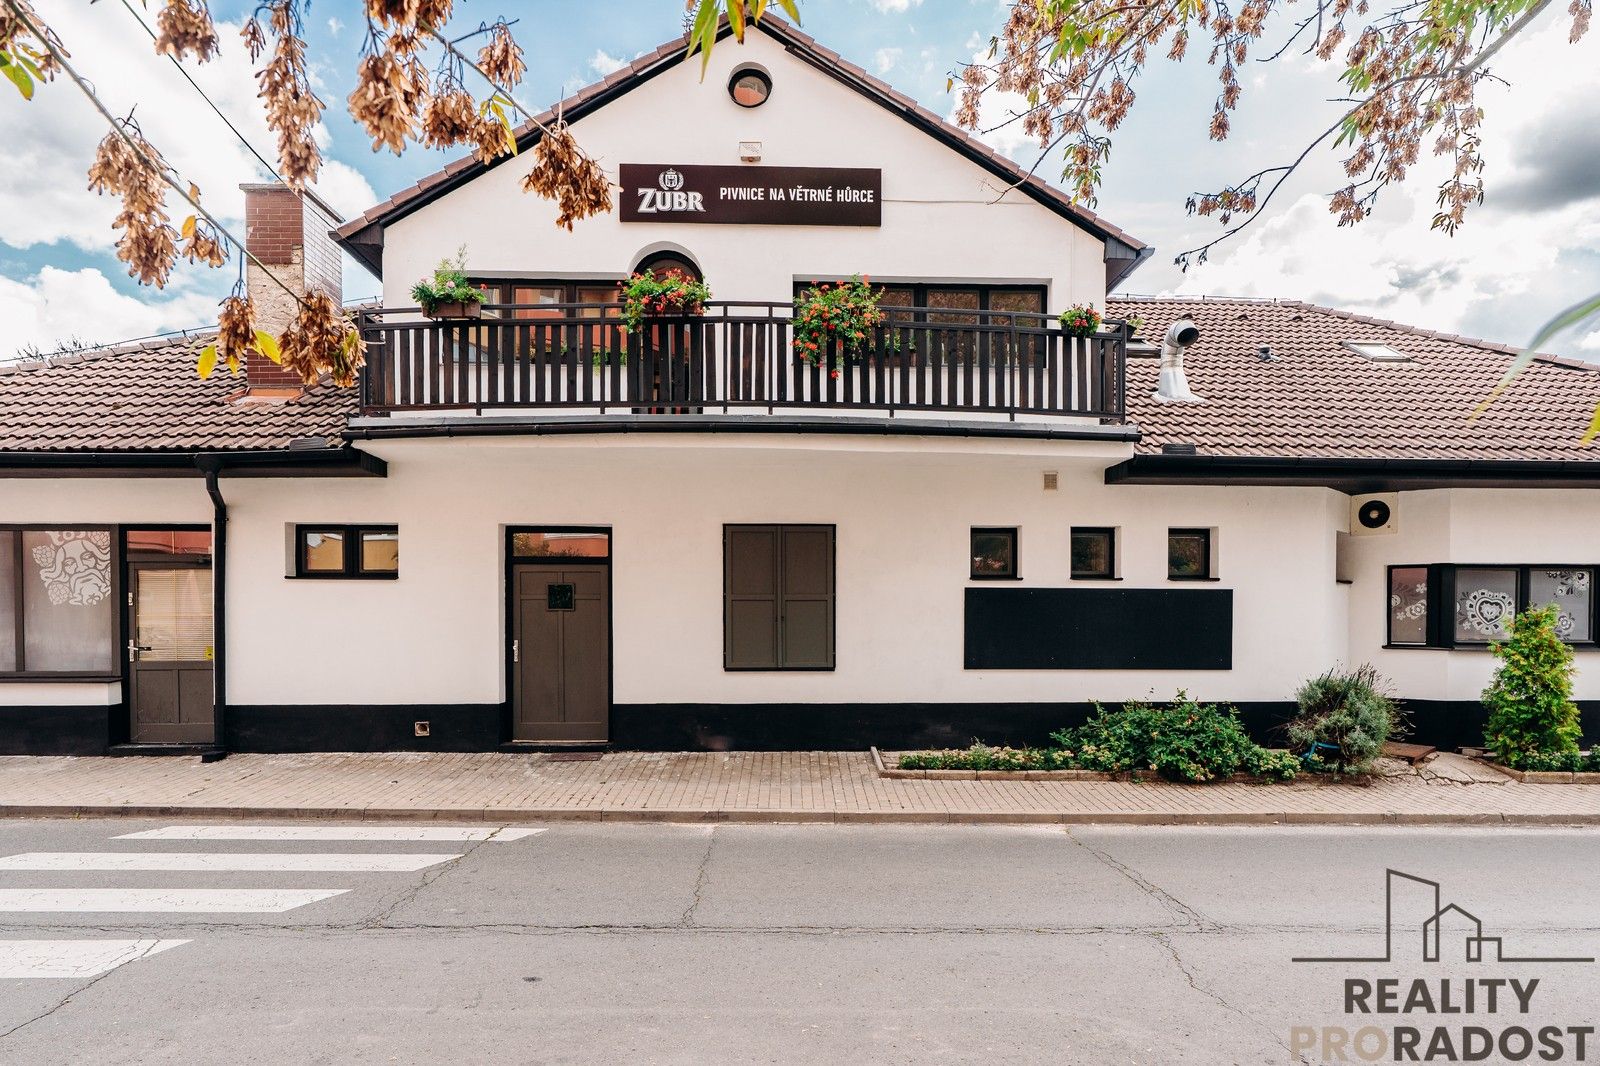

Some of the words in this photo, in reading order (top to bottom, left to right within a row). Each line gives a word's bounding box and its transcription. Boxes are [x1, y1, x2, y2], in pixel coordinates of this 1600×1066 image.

[637, 187, 706, 213] ZUBR
[719, 187, 764, 201] PIVNICE
[769, 188, 786, 201] NA
[788, 185, 832, 202] VĚTRNÉ
[836, 186, 874, 203] HŮRCE
